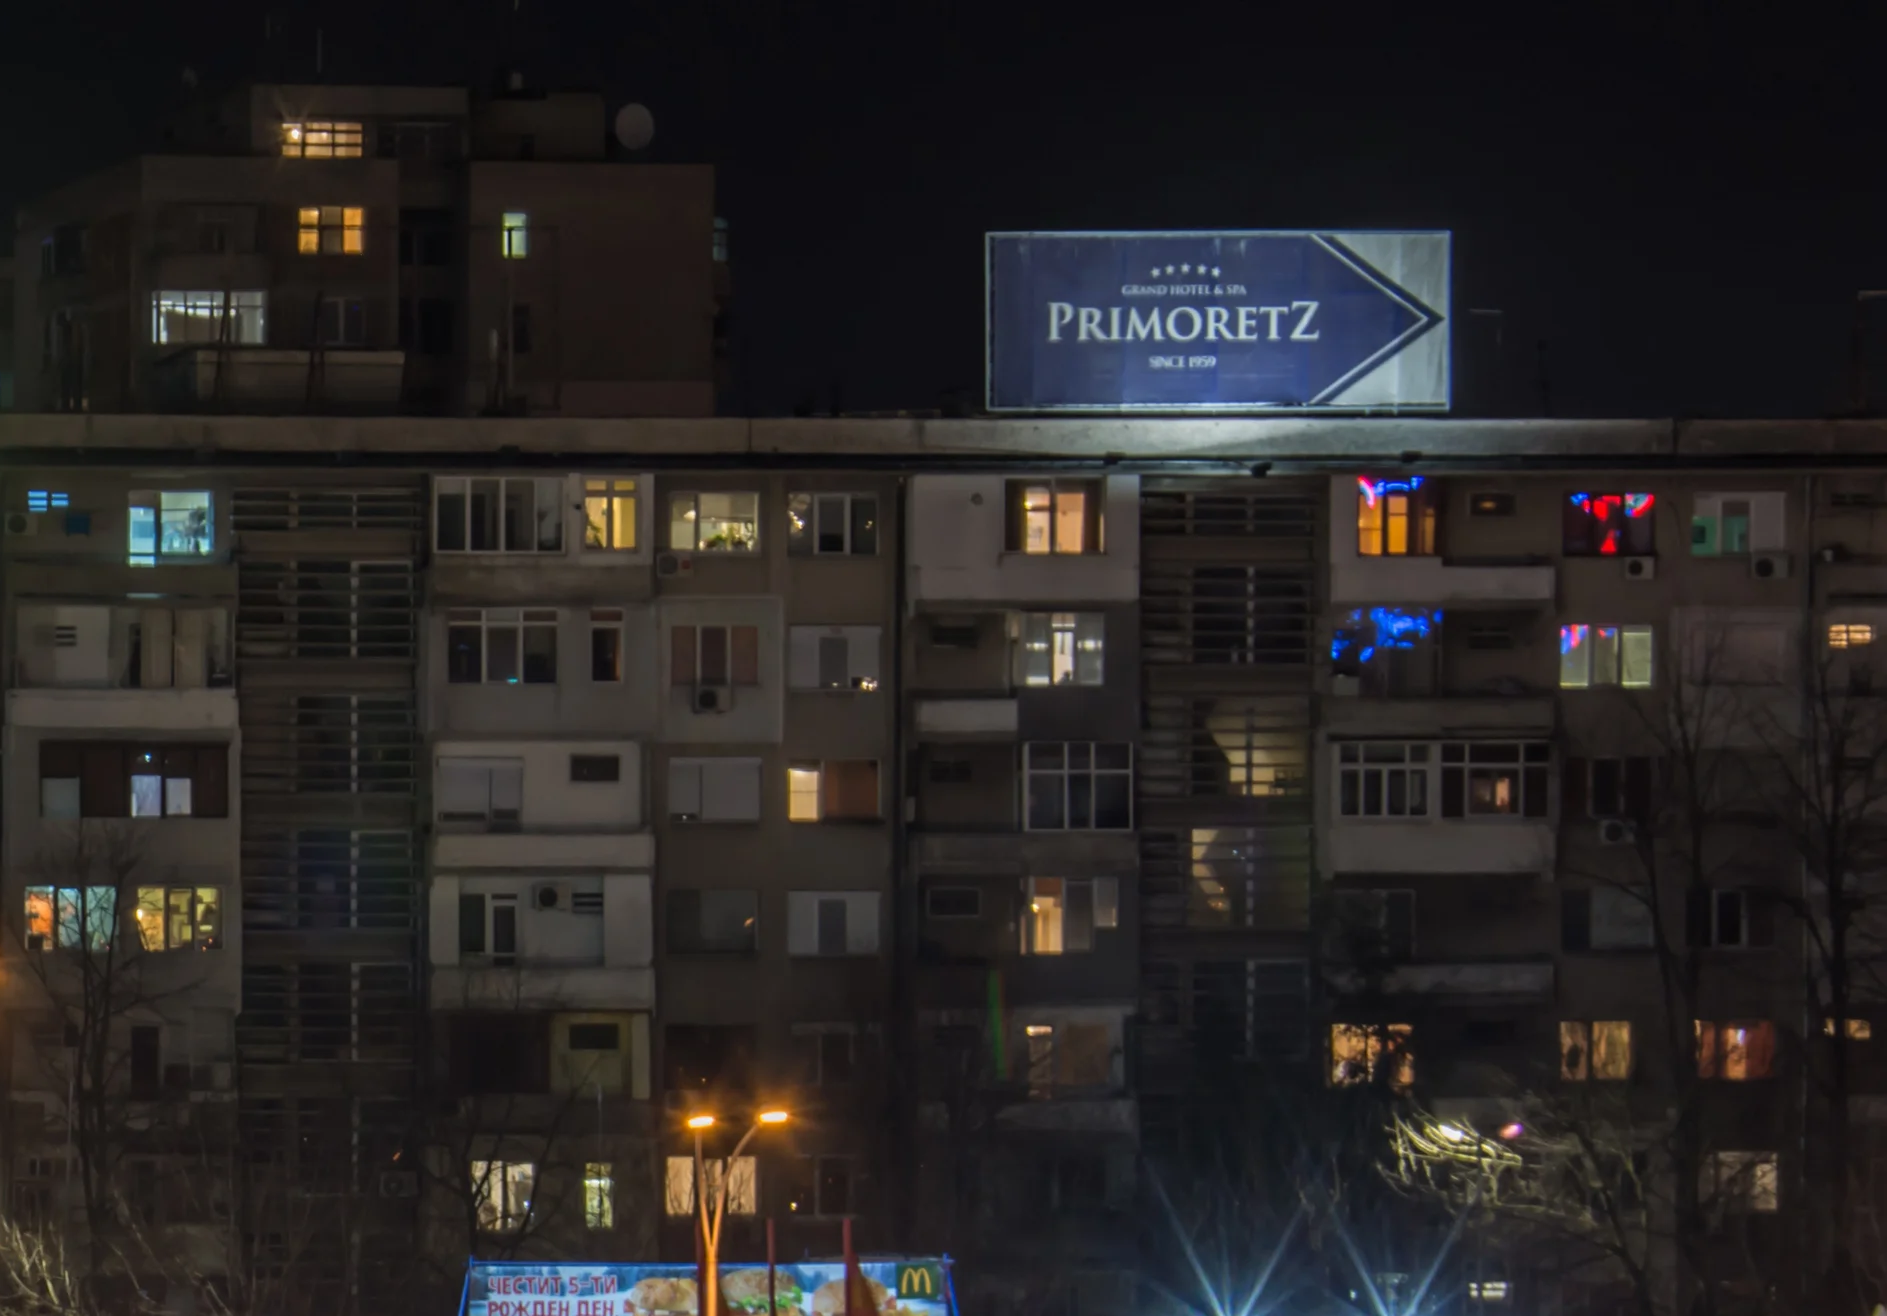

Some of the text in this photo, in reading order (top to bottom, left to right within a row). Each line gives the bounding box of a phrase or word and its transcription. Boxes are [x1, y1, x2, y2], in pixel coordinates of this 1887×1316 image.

[1120, 284, 1247, 295] GRAND HOTEL & SPA
[1148, 355, 1217, 368] SINCE 1959
[488, 1276, 617, 1295] ЧЕСТИТ 5-ТИ
